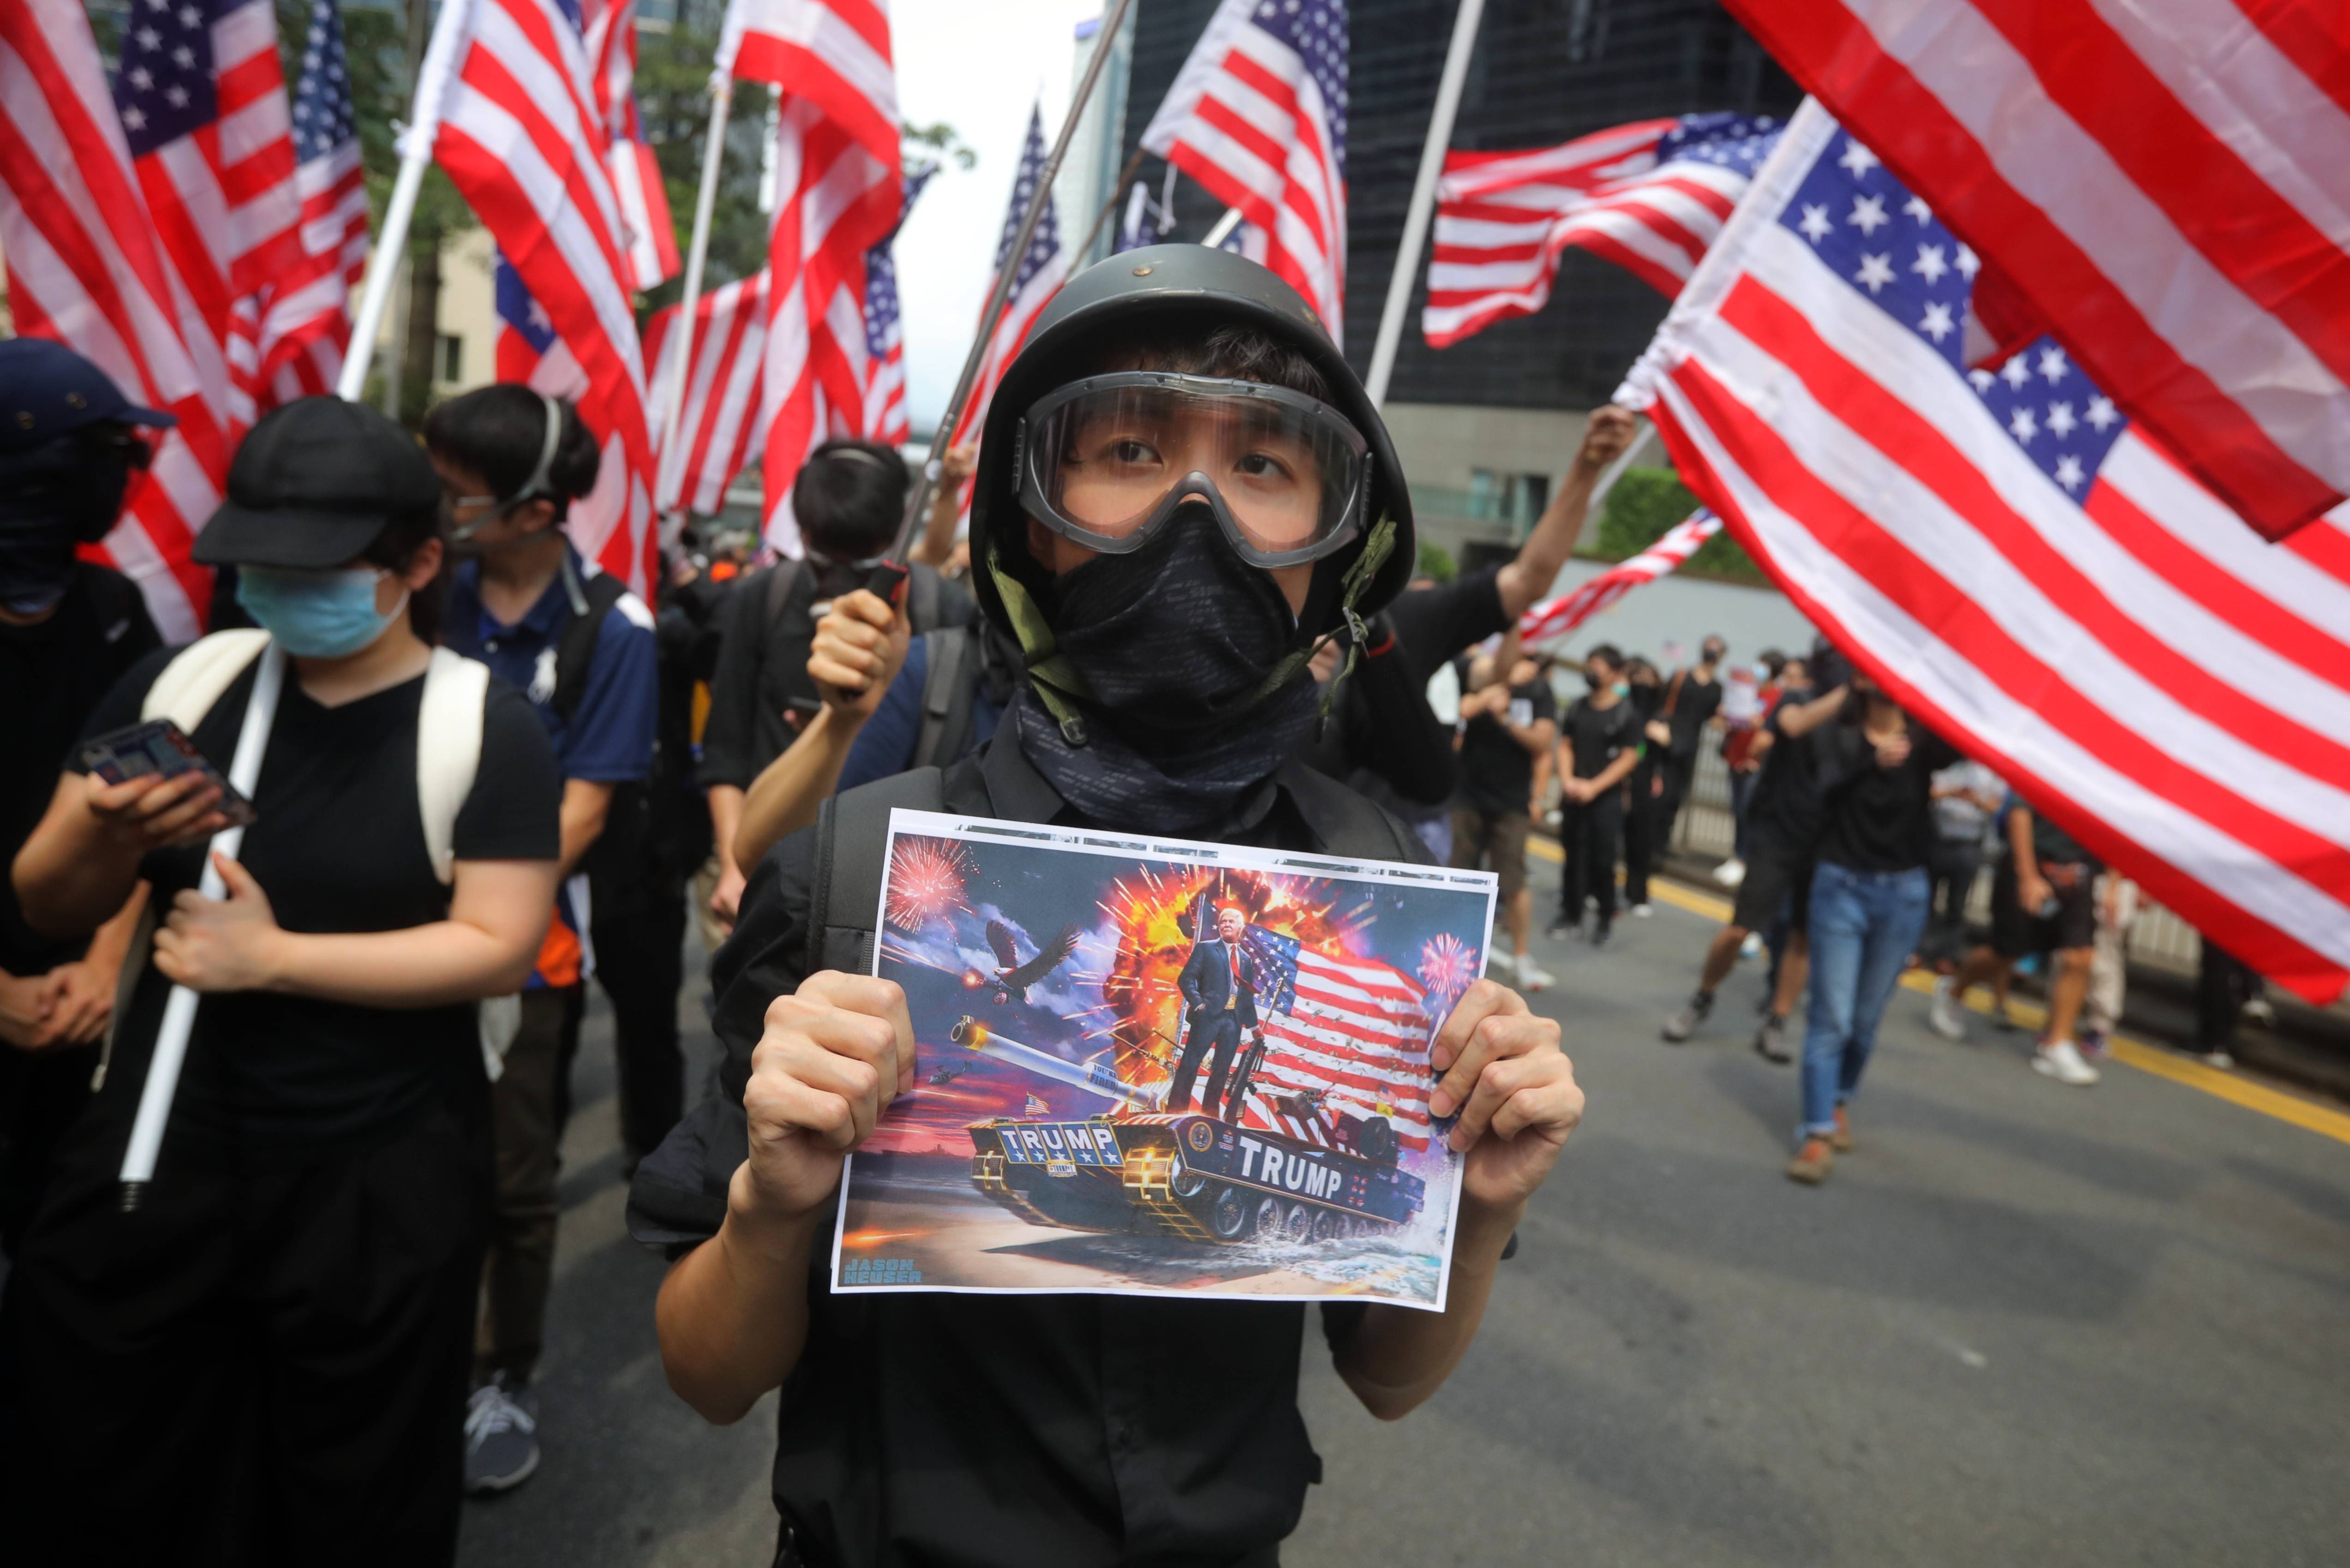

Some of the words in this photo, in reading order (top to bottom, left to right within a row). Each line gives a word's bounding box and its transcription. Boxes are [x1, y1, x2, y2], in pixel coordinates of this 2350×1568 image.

[1002, 1128, 1113, 1149] TRUMP
[1239, 1136, 1342, 1199] TRUMP
[845, 1259, 914, 1271] JASON
[844, 1271, 922, 1284] HEUSER
